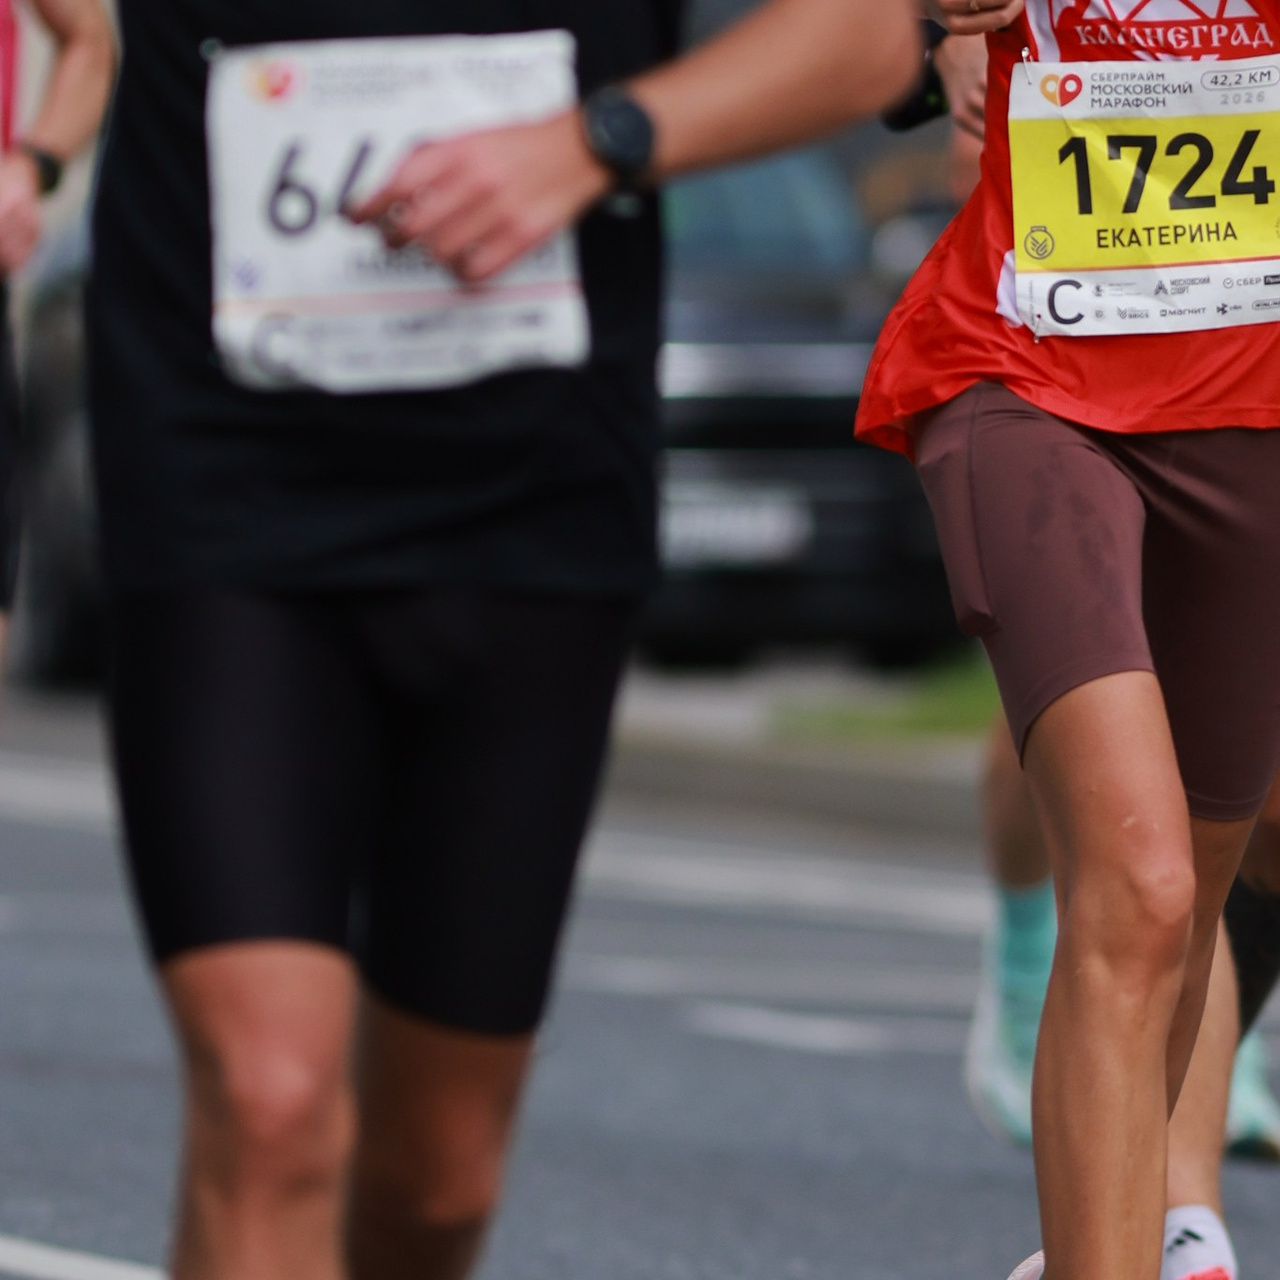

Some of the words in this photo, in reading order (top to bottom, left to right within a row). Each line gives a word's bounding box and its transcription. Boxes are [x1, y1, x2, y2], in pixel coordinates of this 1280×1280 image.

[1090, 72, 1165, 82] СБЕРПРАЙМ
[1210, 74, 1243, 87] 42,2
[1090, 81, 1193, 95] МОСКОВСКИЙ
[1090, 96, 1166, 108] МАРАФОН
[1220, 91, 1266, 105] 2026
[1059, 130, 1275, 215] 1724
[1096, 221, 1238, 249] ЕКАТЕРИНА
[1236, 277, 1262, 287] СБЕР
